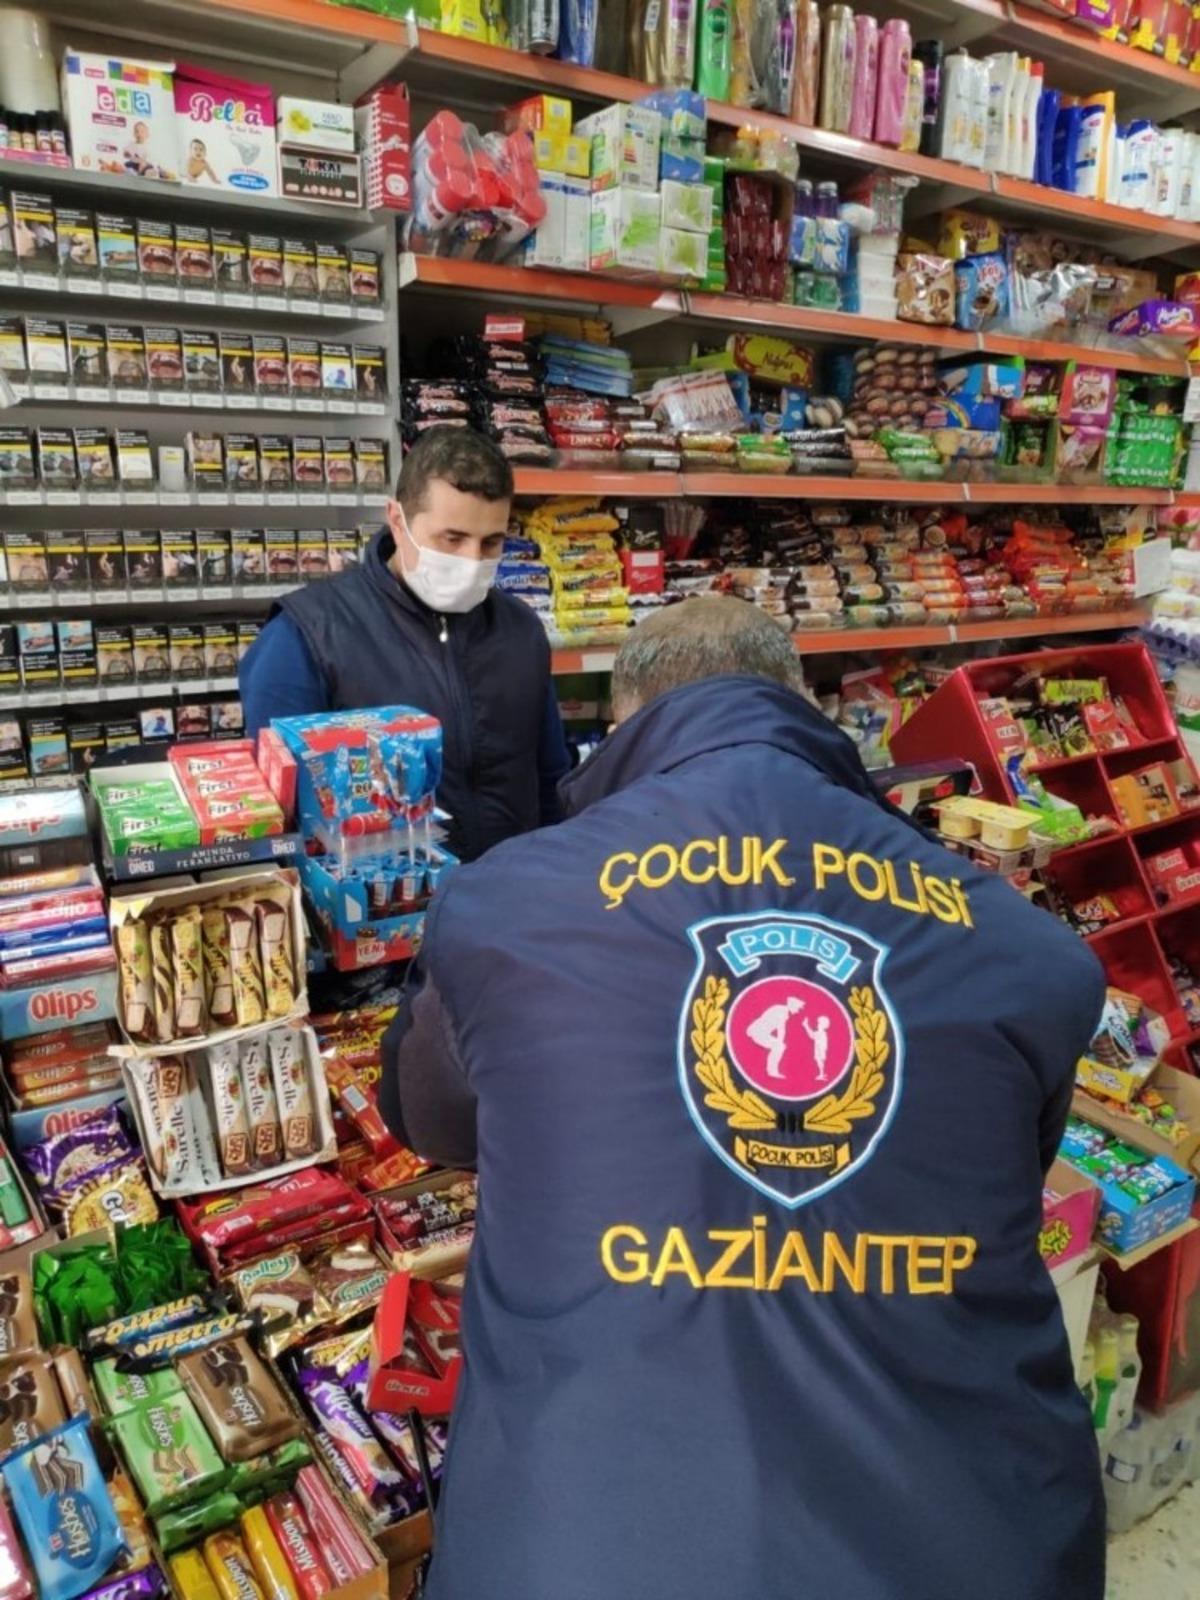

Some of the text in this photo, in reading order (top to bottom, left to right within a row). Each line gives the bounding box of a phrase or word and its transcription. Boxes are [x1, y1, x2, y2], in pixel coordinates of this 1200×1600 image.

[98, 87, 150, 114] eda
[190, 93, 263, 126] Bella
[600, 835, 974, 929] ÇOCUK POLİSİ
[739, 929, 838, 960] POLİS
[32, 988, 98, 1020] Olips
[750, 1144, 793, 1166] ÇOCUK
[601, 1215, 977, 1295] GAZİANTEP
